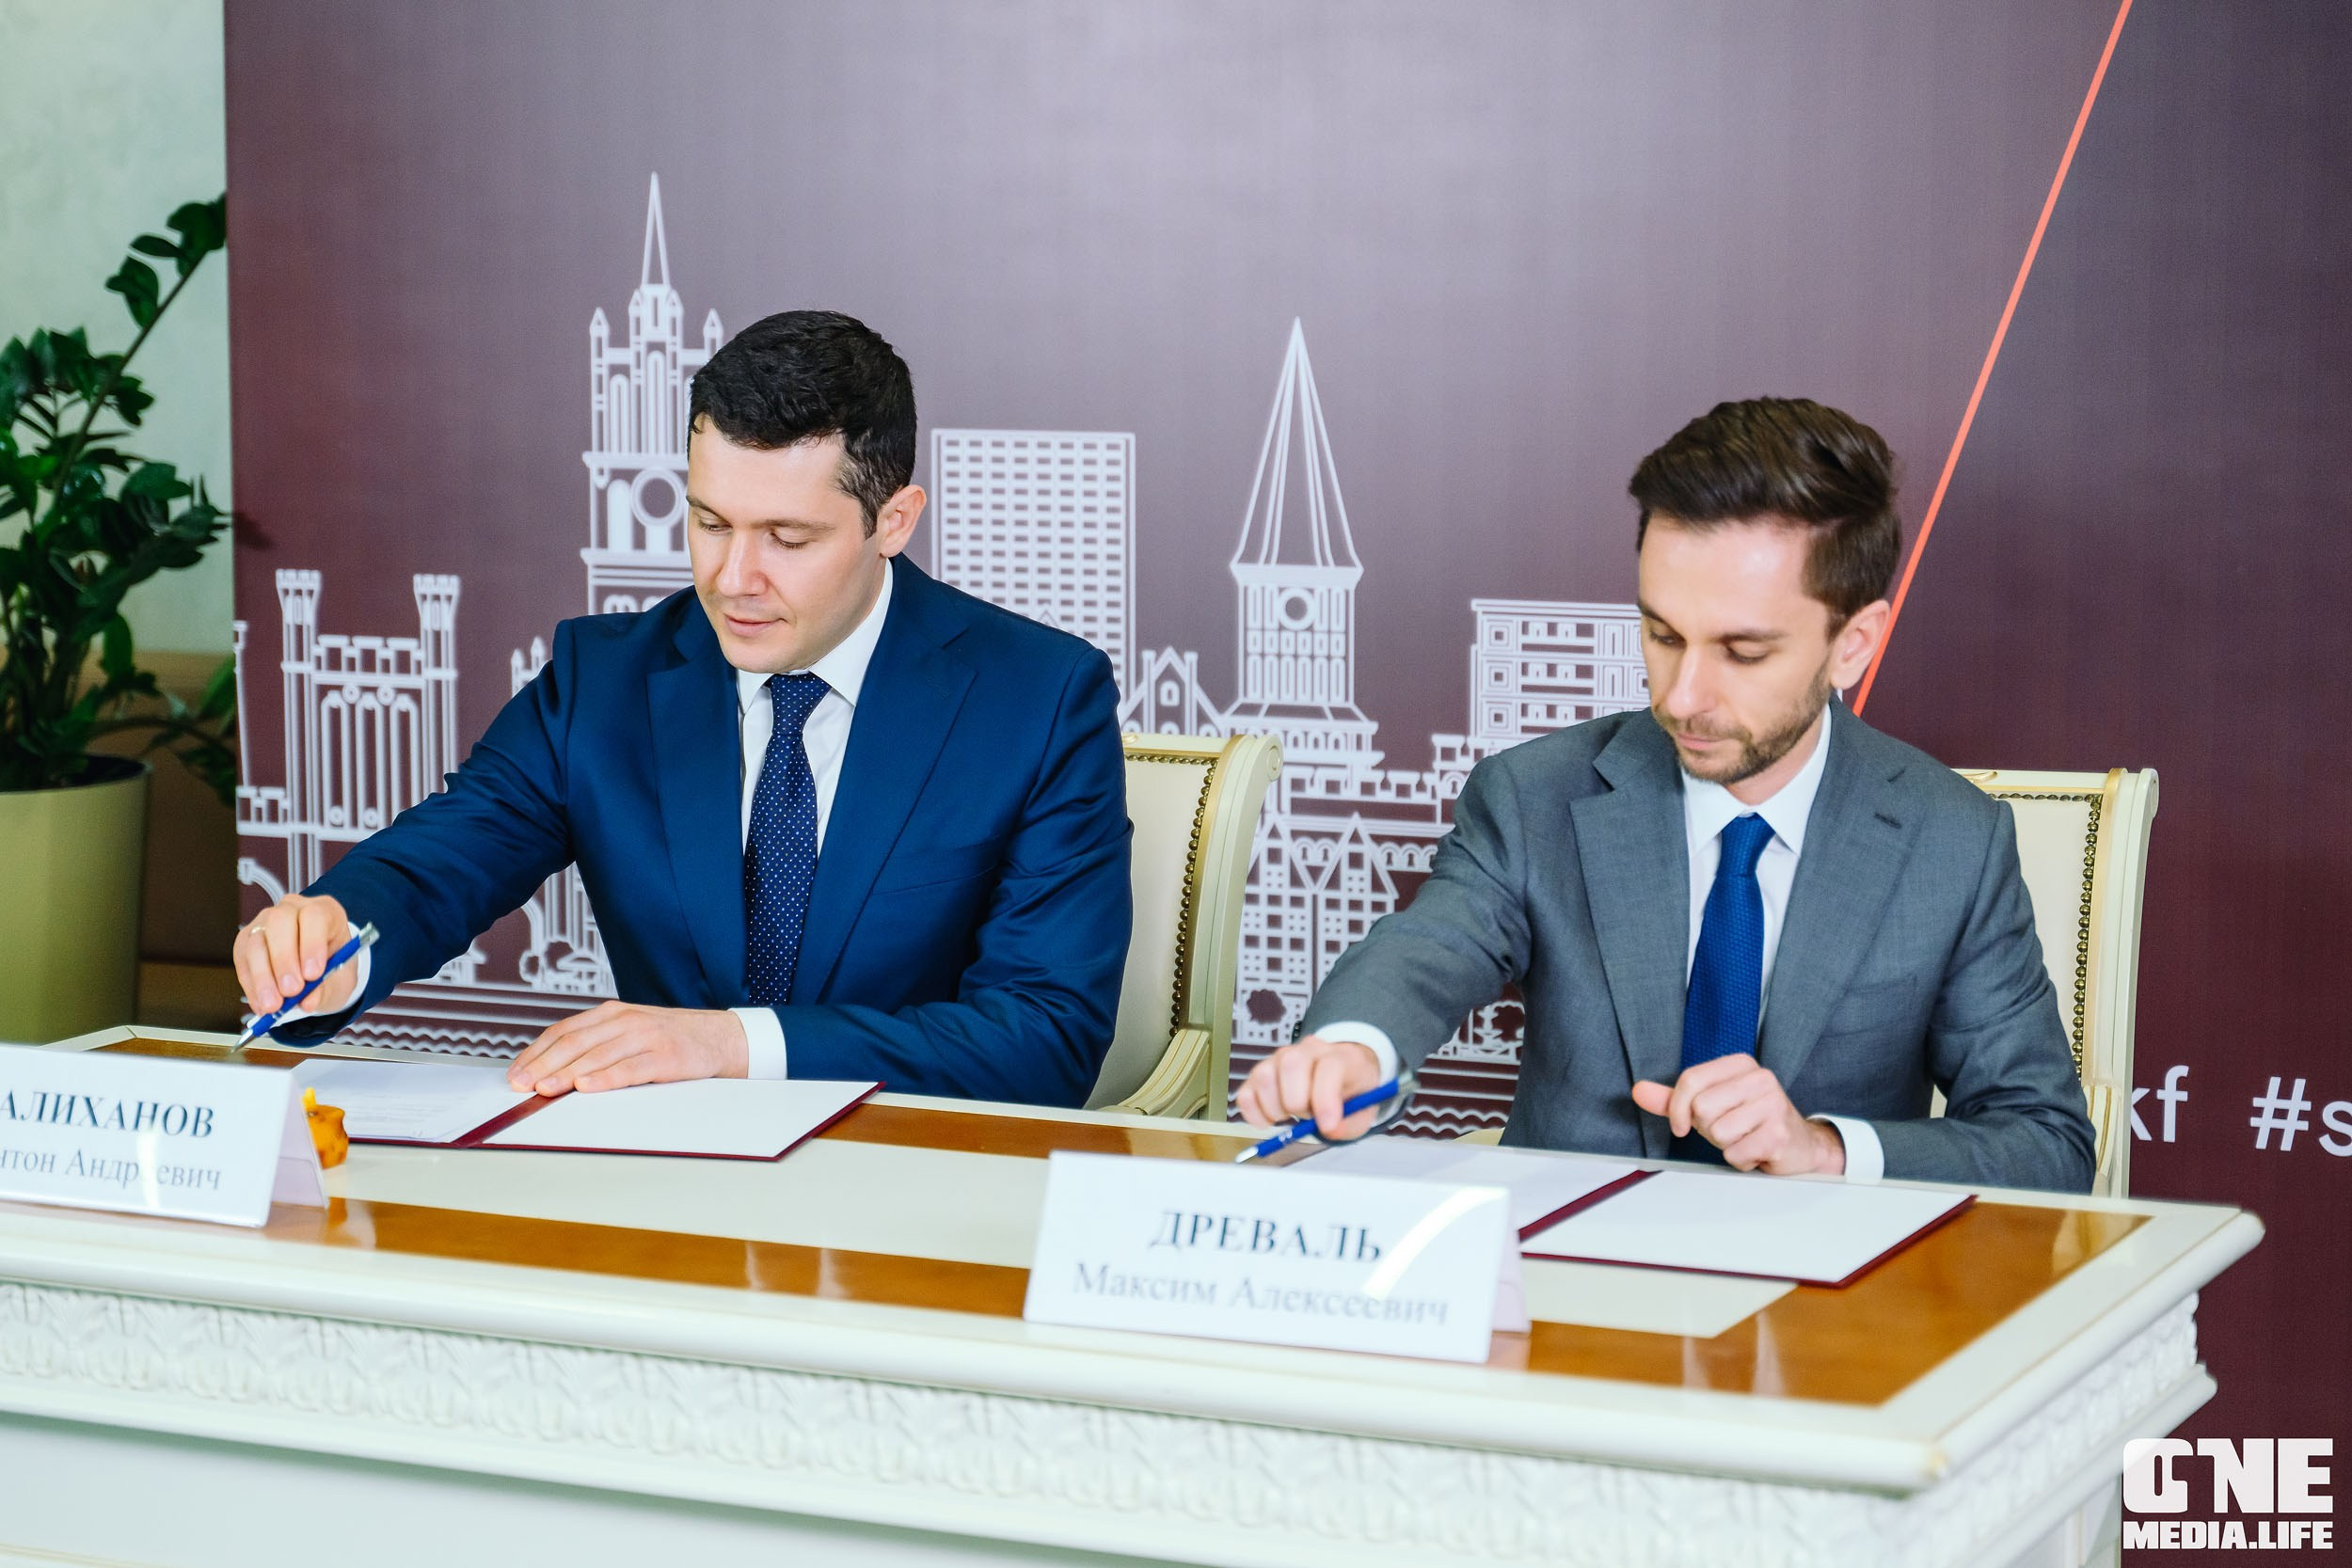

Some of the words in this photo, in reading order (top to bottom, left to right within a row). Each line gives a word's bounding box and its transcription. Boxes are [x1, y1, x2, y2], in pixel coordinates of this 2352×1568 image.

[0, 1089, 215, 1138] АЛИХАНОВ
[64, 1148, 222, 1191] Андревич
[1148, 1210, 1382, 1262] ДРЕВАЛЬ
[1073, 1262, 1218, 1305] Максим
[1228, 1275, 1450, 1327] Алексеевич
